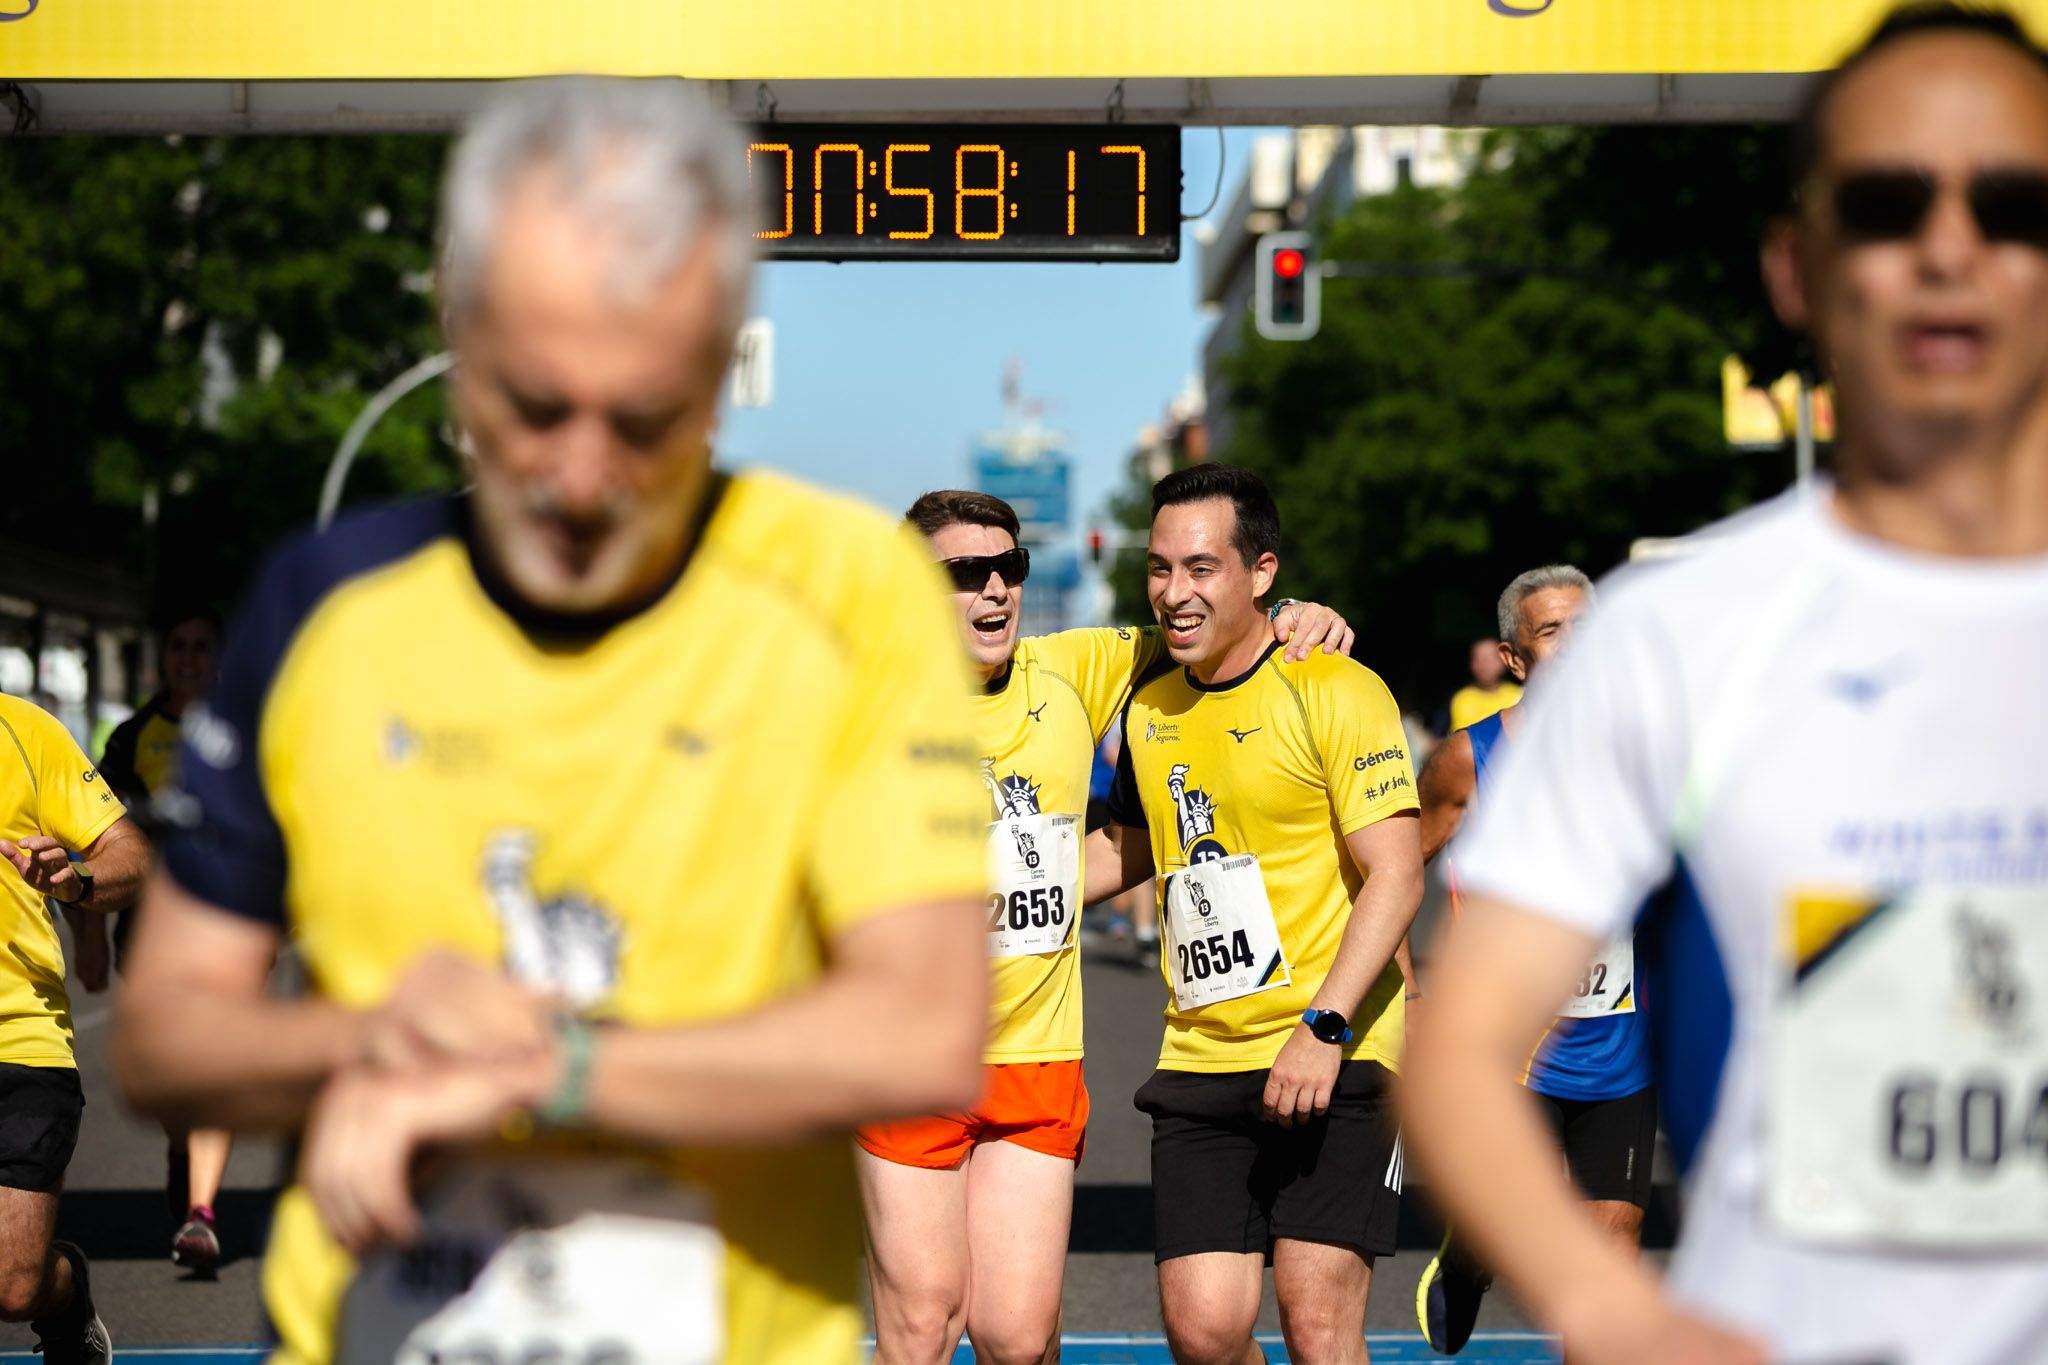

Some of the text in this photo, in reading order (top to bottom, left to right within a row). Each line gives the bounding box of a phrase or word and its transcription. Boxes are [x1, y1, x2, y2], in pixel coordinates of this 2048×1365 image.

[1157, 723, 1180, 732] Liberty
[987, 886, 1064, 932] 2653
[1177, 929, 1255, 984] 2654
